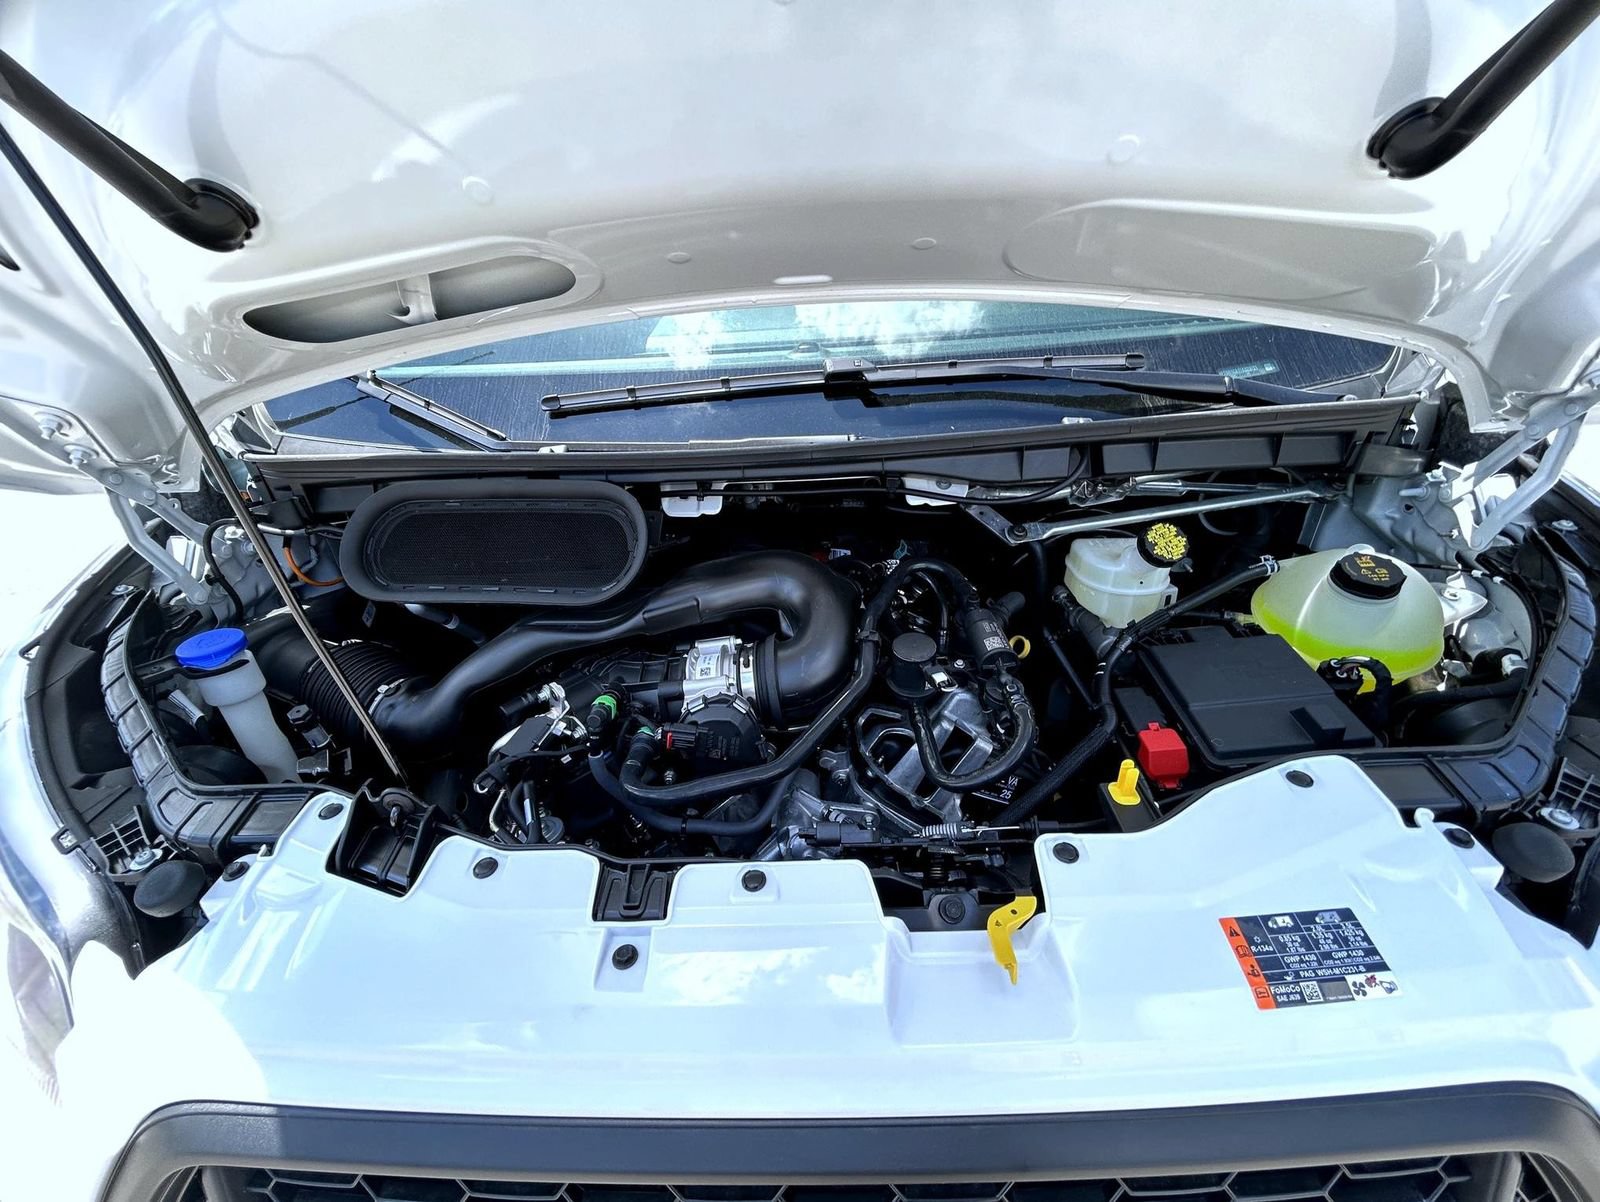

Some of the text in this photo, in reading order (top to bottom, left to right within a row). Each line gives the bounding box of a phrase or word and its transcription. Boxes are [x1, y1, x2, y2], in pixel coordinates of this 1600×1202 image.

[1000, 789, 1012, 799] 25
[1278, 934, 1301, 942] 0.85 kg
[1299, 965, 1366, 978] PAG WSH-M1C231-B
[1270, 984, 1301, 994] FoMoCo
